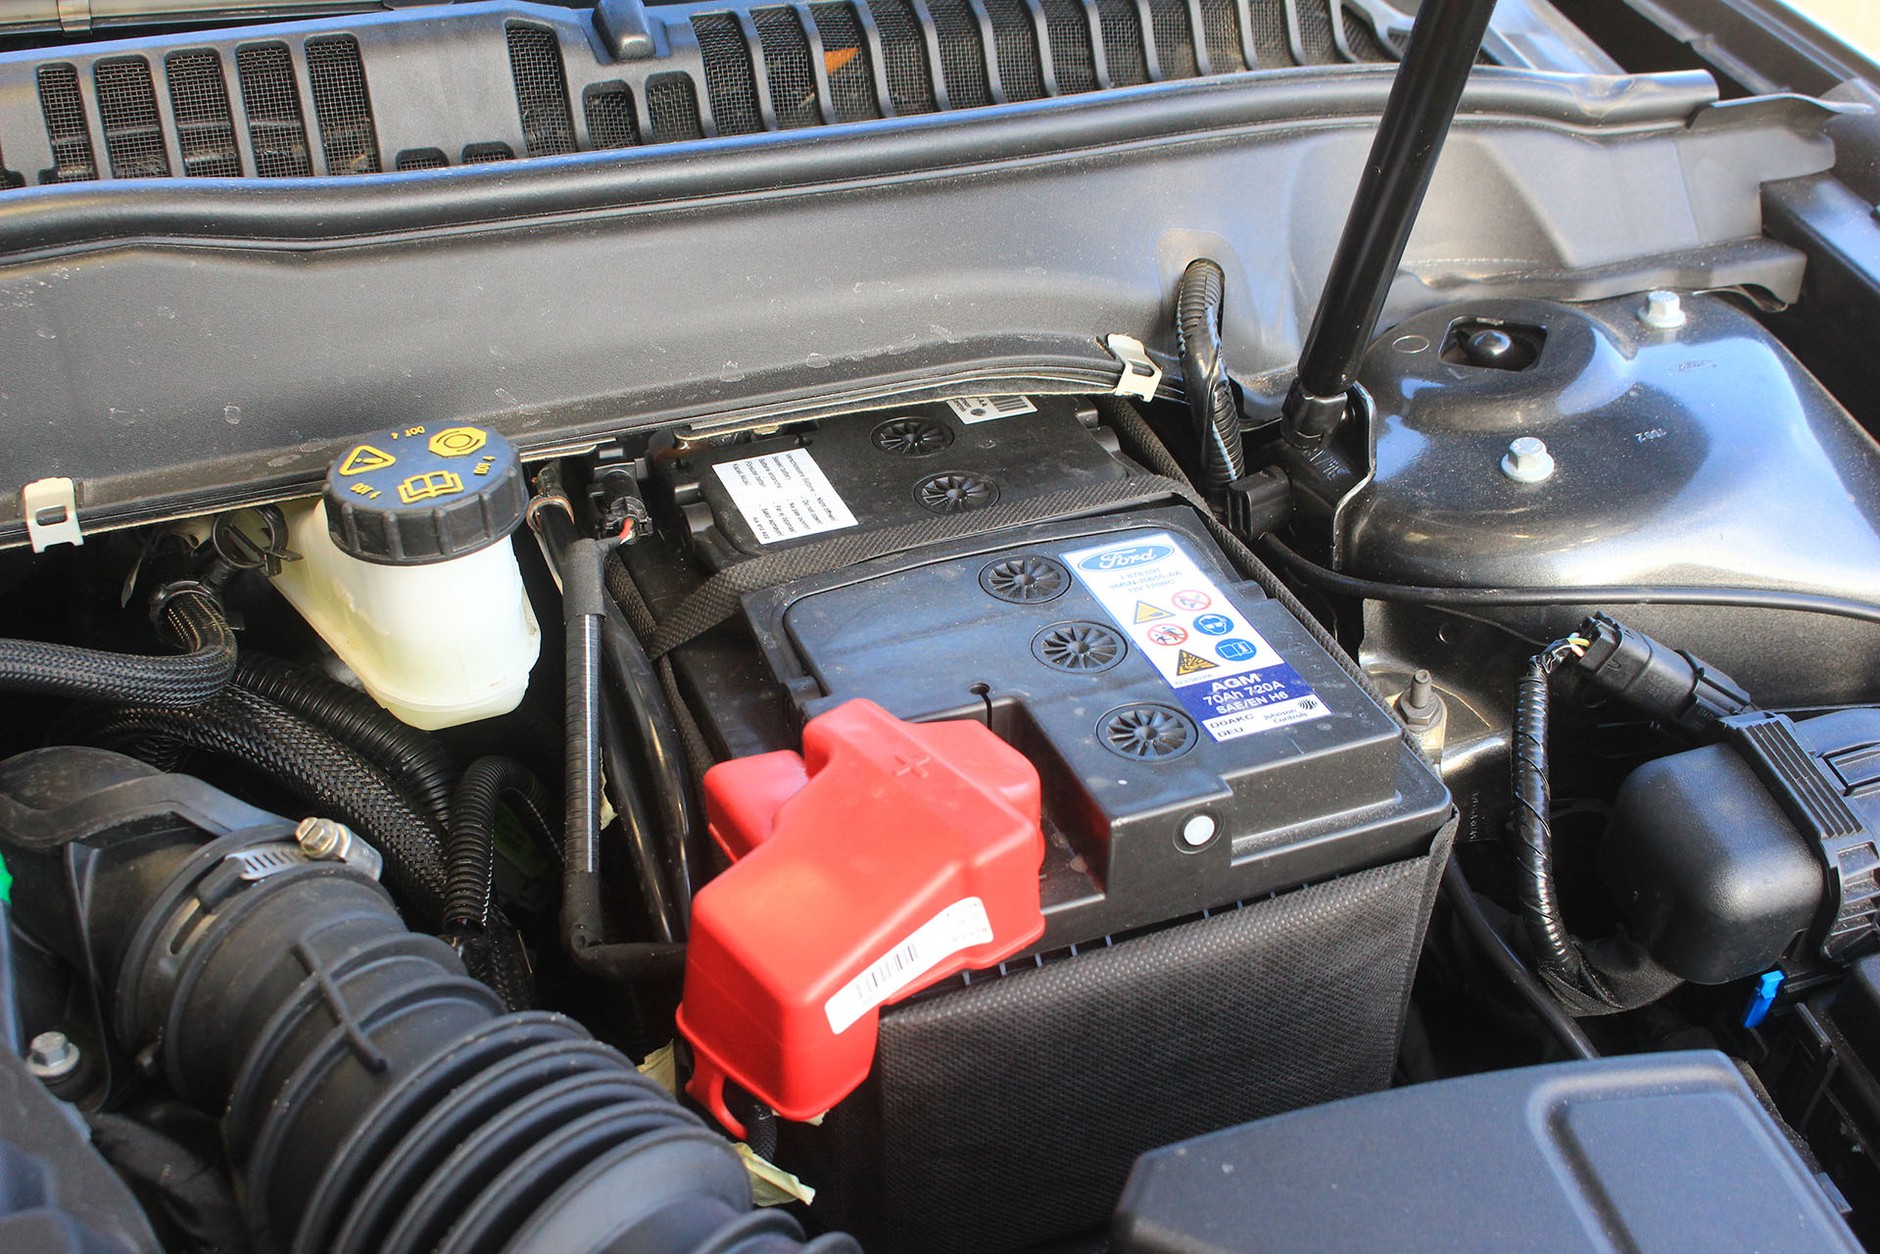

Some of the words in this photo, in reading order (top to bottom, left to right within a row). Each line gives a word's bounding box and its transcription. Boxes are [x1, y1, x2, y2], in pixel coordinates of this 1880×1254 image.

[390, 432, 398, 441] 4
[405, 425, 425, 438] DOT
[350, 482, 374, 496] DOT
[1099, 548, 1157, 569] Ford
[1211, 673, 1262, 693] AGM
[1202, 689, 1242, 707] 70Ah
[1244, 680, 1286, 697] 720A
[1216, 696, 1270, 715] SAE/EN
[1270, 691, 1290, 704] H6
[1217, 726, 1245, 739] DEU
